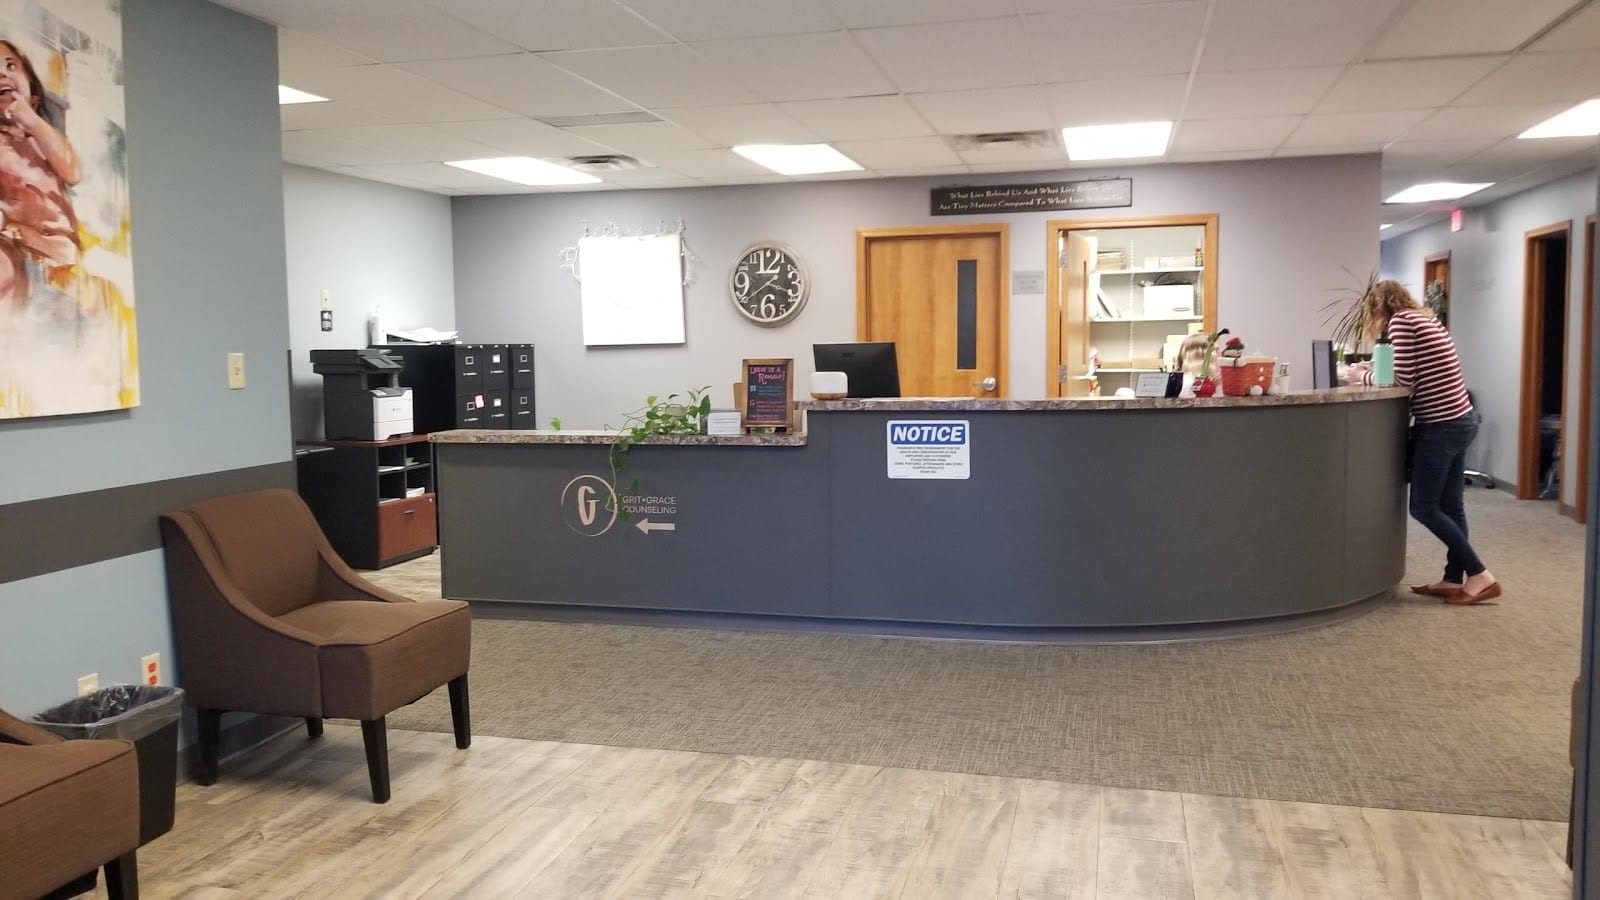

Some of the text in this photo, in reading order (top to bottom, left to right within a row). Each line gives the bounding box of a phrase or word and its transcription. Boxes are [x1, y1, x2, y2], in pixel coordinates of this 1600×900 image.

[970, 191, 984, 199] Lies
[985, 189, 1010, 198] Behind
[1023, 188, 1038, 196] And
[1039, 186, 1059, 195] What
[1060, 185, 1075, 193] Lies
[952, 202, 969, 211] Tiny
[970, 201, 997, 209] Matters
[998, 199, 1034, 208] Compared
[1035, 198, 1047, 206] To
[1048, 197, 1067, 205] What
[755, 249, 781, 274] 12
[734, 271, 750, 298] 9
[787, 270, 801, 297] 3
[760, 293, 776, 320] 6
[893, 426, 964, 442] NOTICE
[622, 495, 677, 505] GRIT+GRACE
[622, 505, 677, 514] COUNSELING
